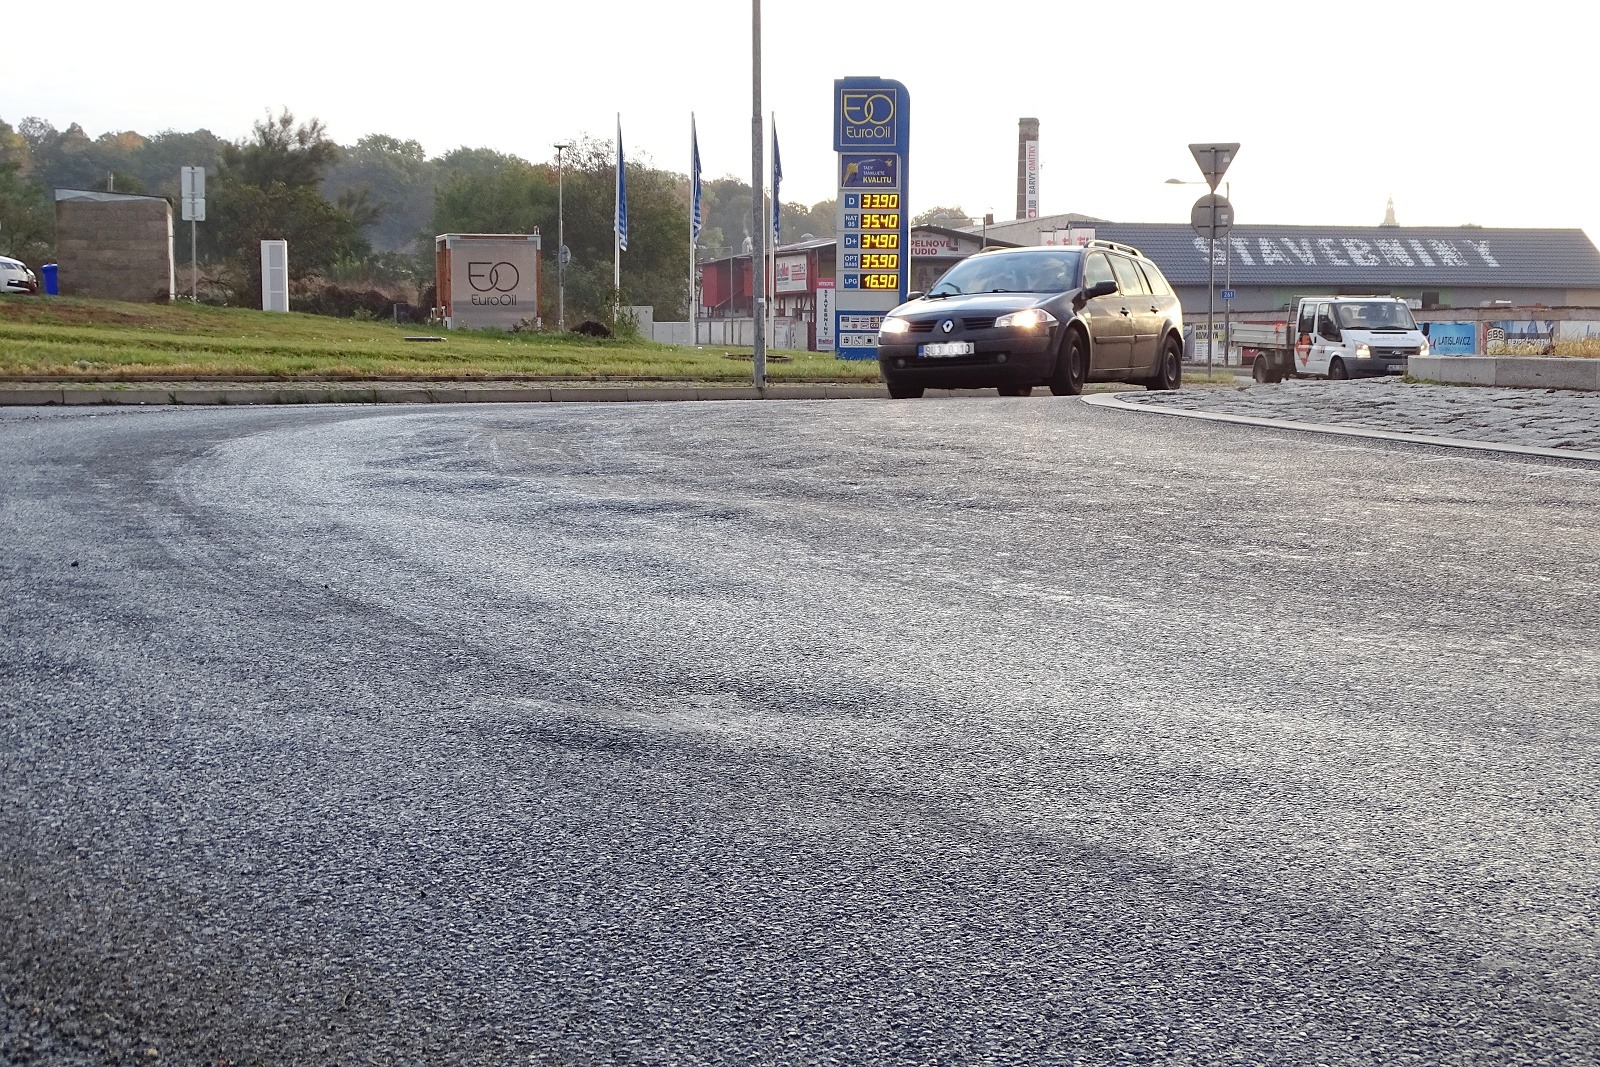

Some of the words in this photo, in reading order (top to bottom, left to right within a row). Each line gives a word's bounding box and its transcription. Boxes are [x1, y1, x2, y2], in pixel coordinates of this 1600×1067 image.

[846, 126, 890, 138] EuroOil
[1028, 172, 1036, 195] BARVY
[848, 197, 855, 205] D
[845, 237, 857, 245] D+
[1193, 237, 1500, 267] STAVEBNINY
[471, 294, 517, 306] EuroOil
[1487, 330, 1504, 340] SBS
